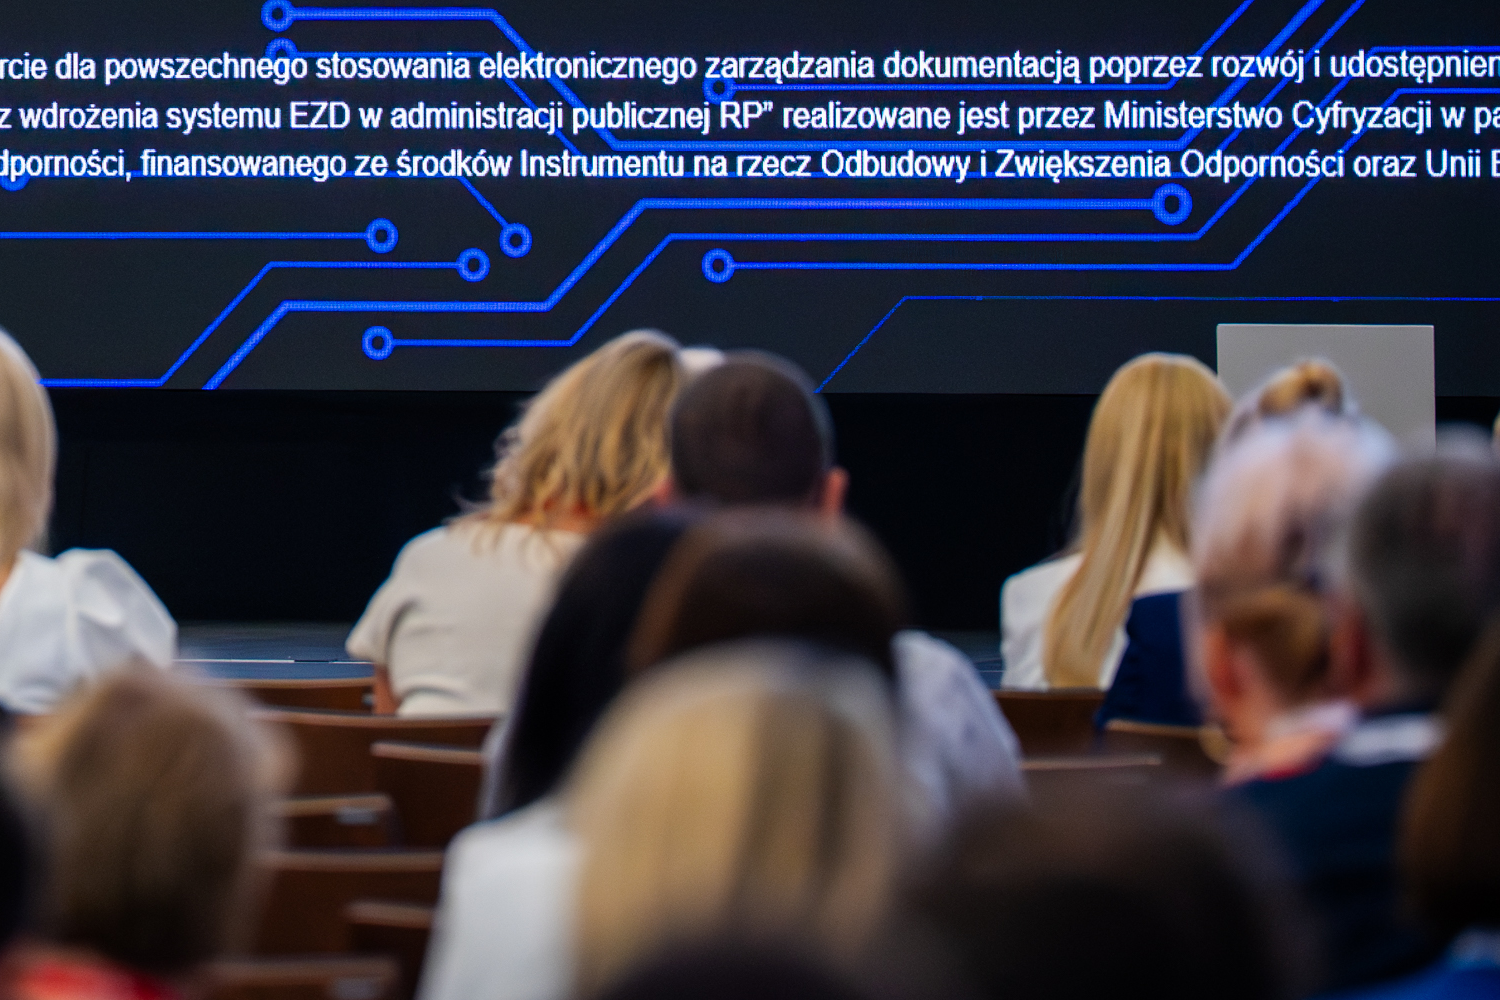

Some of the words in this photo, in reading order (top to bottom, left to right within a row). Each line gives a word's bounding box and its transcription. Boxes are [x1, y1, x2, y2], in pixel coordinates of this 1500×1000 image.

[55, 51, 96, 80] dla
[104, 51, 308, 86] powszechnego
[315, 51, 471, 79] stosowania
[479, 50, 697, 85] elektronicznego
[705, 50, 875, 85] zarządzania
[883, 50, 1082, 84] dokumentacją
[1089, 56, 1204, 84] poprzez
[1212, 49, 1304, 84] rozwój
[1314, 49, 1320, 78] i
[17, 101, 159, 129] wdrożenia
[166, 101, 281, 135] systemu
[290, 101, 351, 129] EZD
[358, 107, 383, 129] w
[390, 101, 563, 136] administracji
[572, 100, 711, 136] publicznej
[783, 100, 951, 129] realizowane
[956, 100, 1010, 136] jest
[1018, 106, 1096, 135] przez
[1105, 100, 1283, 129] Ministerstwo
[1292, 100, 1432, 135] Cyfryzacji
[1441, 106, 1466, 128] w
[139, 148, 347, 183] finansowanego
[354, 155, 389, 177] ze
[396, 148, 513, 177] środków
[521, 148, 685, 177] Instrumentu
[693, 155, 729, 177] na
[736, 154, 812, 177] rzecz
[821, 148, 971, 184] Odbudowy
[980, 149, 987, 177] i
[994, 148, 1172, 184] Zwiększenia
[1180, 148, 1344, 184] Odporności
[1353, 155, 1417, 178] oraz
[1426, 148, 1481, 178] Unii
